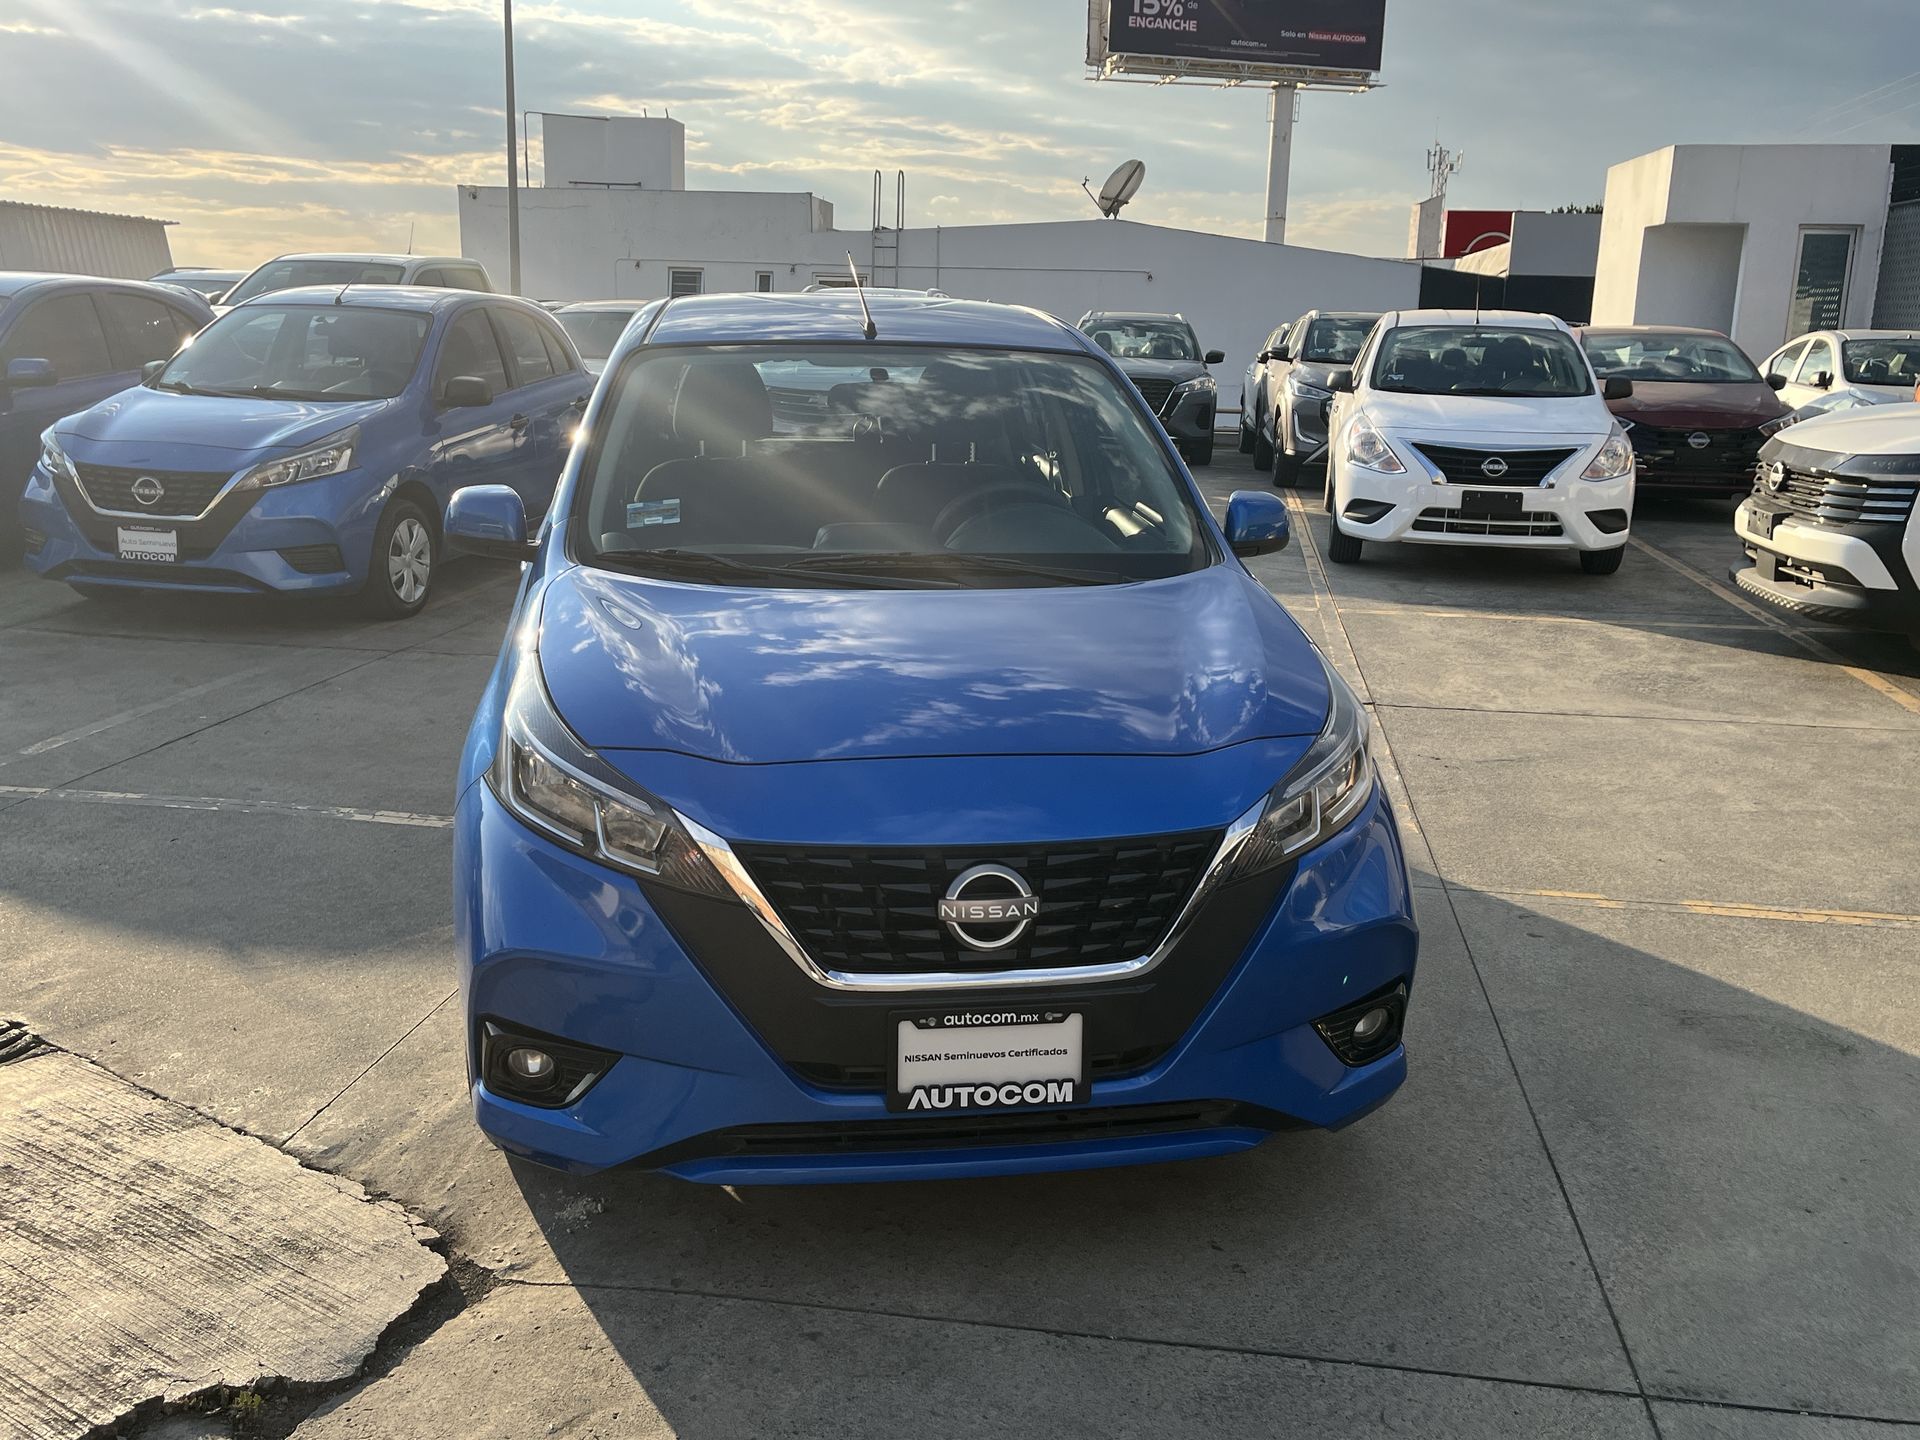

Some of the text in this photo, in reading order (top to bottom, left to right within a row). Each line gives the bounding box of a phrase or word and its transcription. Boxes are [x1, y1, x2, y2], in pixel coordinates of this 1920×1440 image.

[1187, 1, 1199, 9] de
[1128, 16, 1198, 31] ENGANCHE
[1280, 30, 1297, 38] Solo
[1308, 32, 1332, 41] Nissan
[1332, 34, 1367, 44] AUTOCOM
[121, 551, 175, 562] AUTOCOM
[941, 902, 1038, 919] NISSAN
[943, 1012, 1039, 1025] autocom.mx
[904, 1048, 1068, 1063] NISSAN Seminuevos Certificados
[907, 1082, 1074, 1110] AUTOCOM
